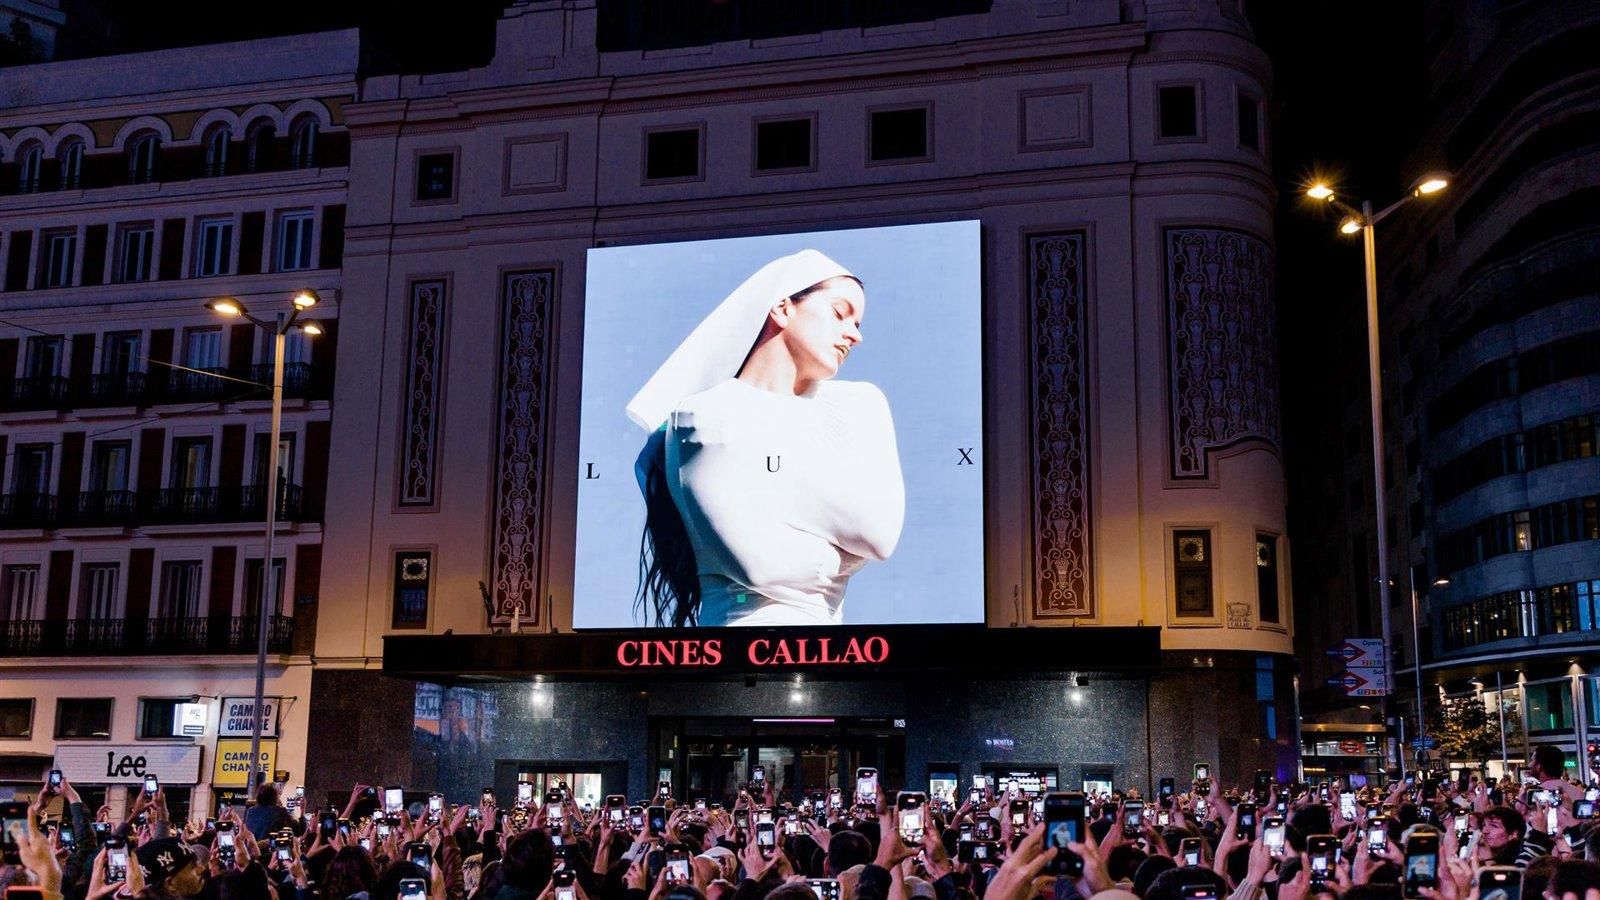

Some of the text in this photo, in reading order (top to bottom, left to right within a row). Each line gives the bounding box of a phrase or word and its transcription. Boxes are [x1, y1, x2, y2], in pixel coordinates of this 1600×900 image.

[585, 447, 974, 479] L U X
[617, 636, 890, 666] CINES CALLAO
[106, 751, 147, 777] Lee
